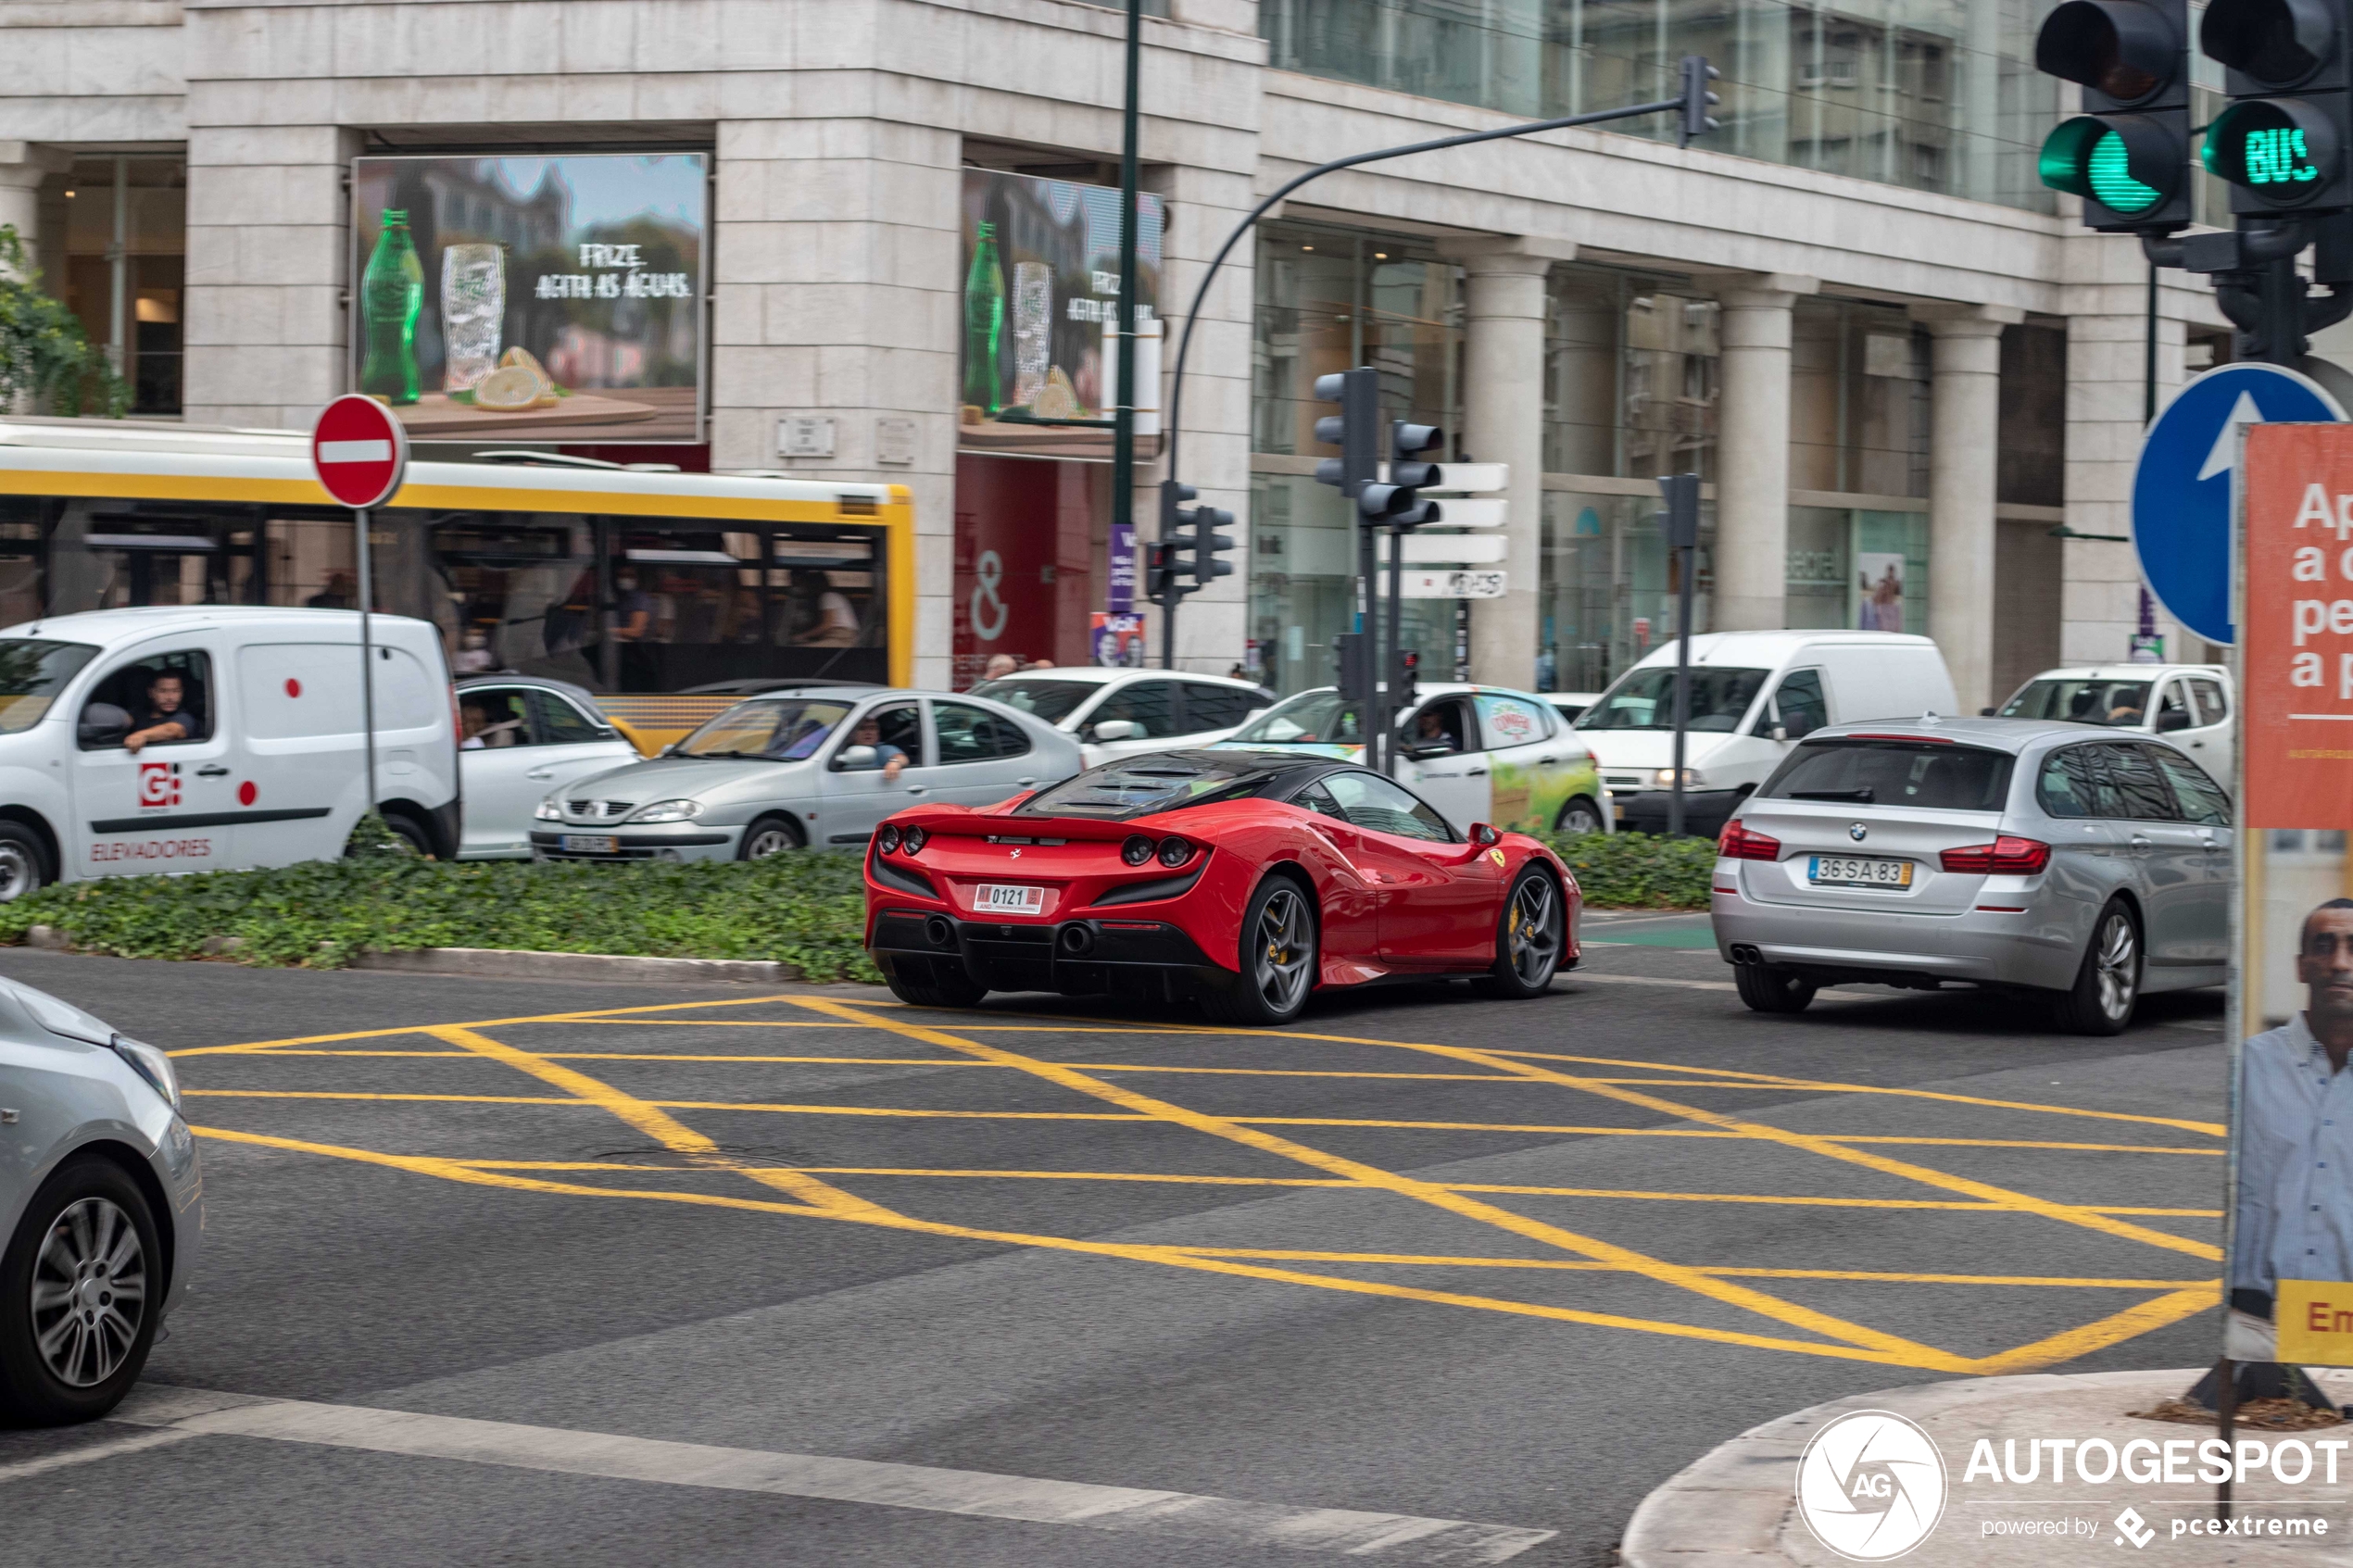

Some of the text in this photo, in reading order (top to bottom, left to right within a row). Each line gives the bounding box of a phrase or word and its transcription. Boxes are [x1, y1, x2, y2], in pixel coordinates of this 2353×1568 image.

[2246, 128, 2319, 183] BUS
[2292, 546, 2327, 582] a
[2290, 652, 2325, 687] a
[91, 838, 211, 862] ELEVADORES
[1819, 859, 1901, 882] 36-SA-83
[992, 888, 1023, 906] 0121
